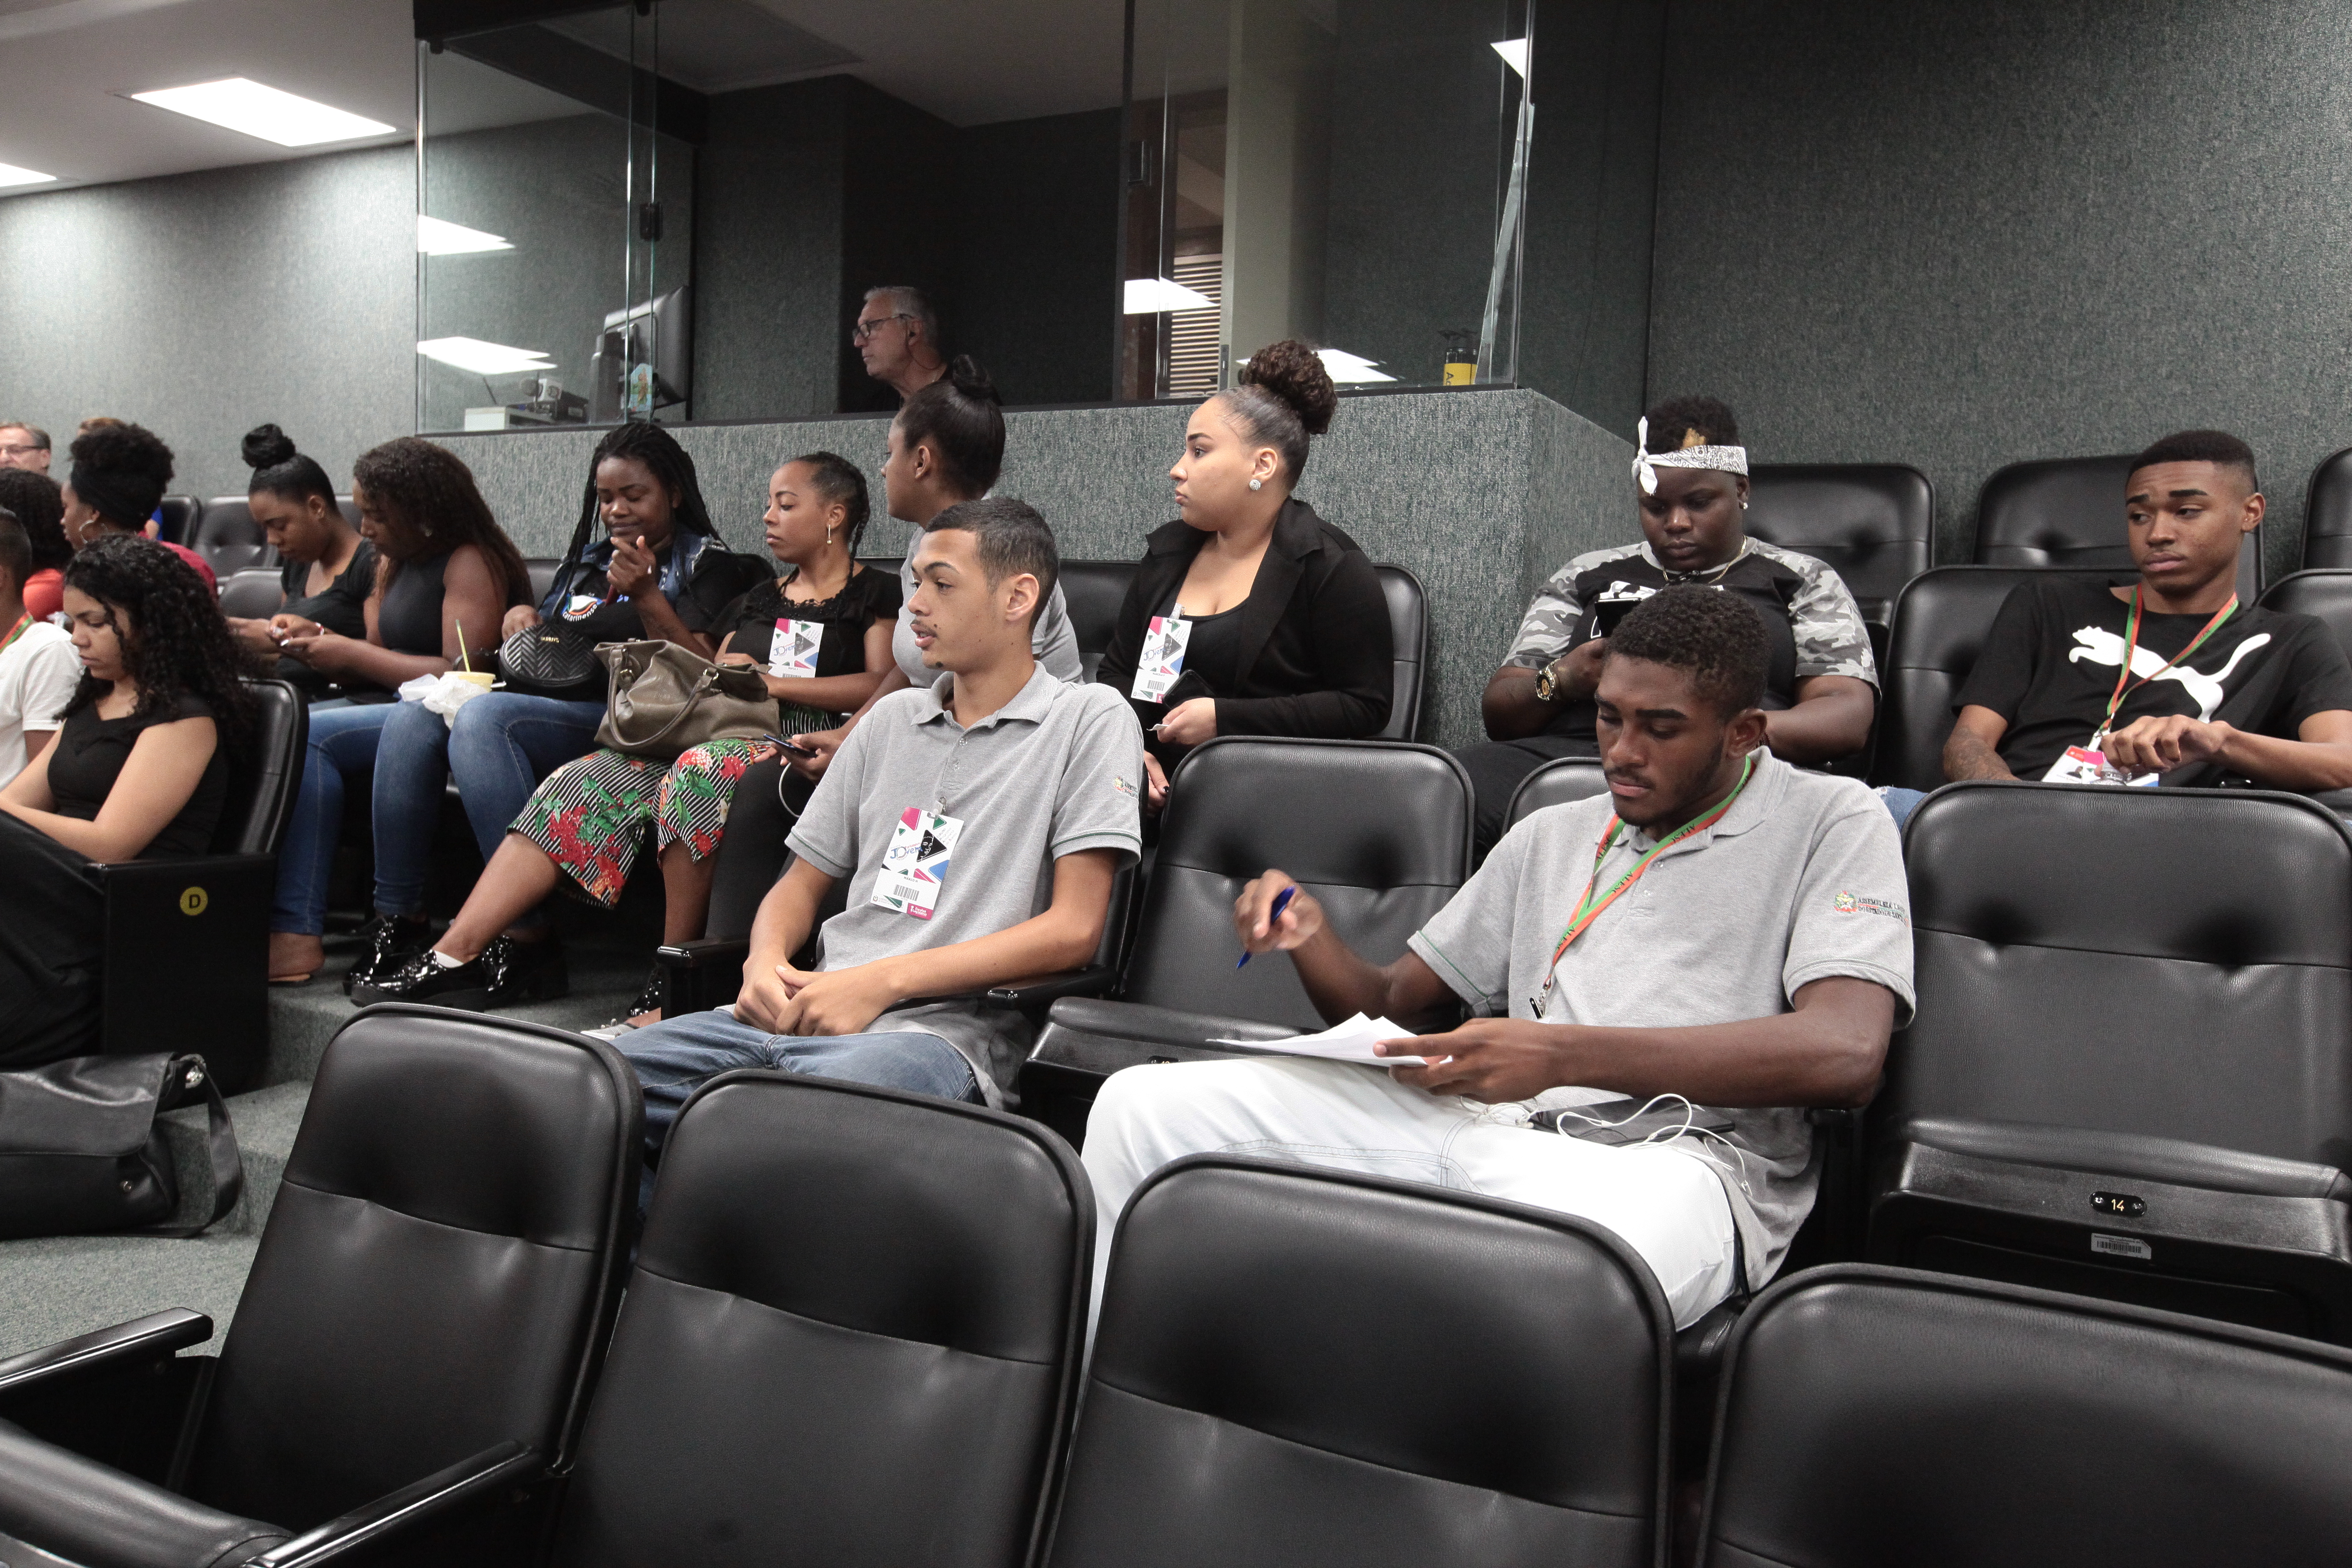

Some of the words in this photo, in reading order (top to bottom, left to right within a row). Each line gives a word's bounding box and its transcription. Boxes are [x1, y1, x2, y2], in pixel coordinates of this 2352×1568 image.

[562, 603, 598, 622] catarinense
[1610, 871, 1633, 893] ALESC
[189, 894, 201, 908] D
[2111, 1199, 2124, 1212] 14
